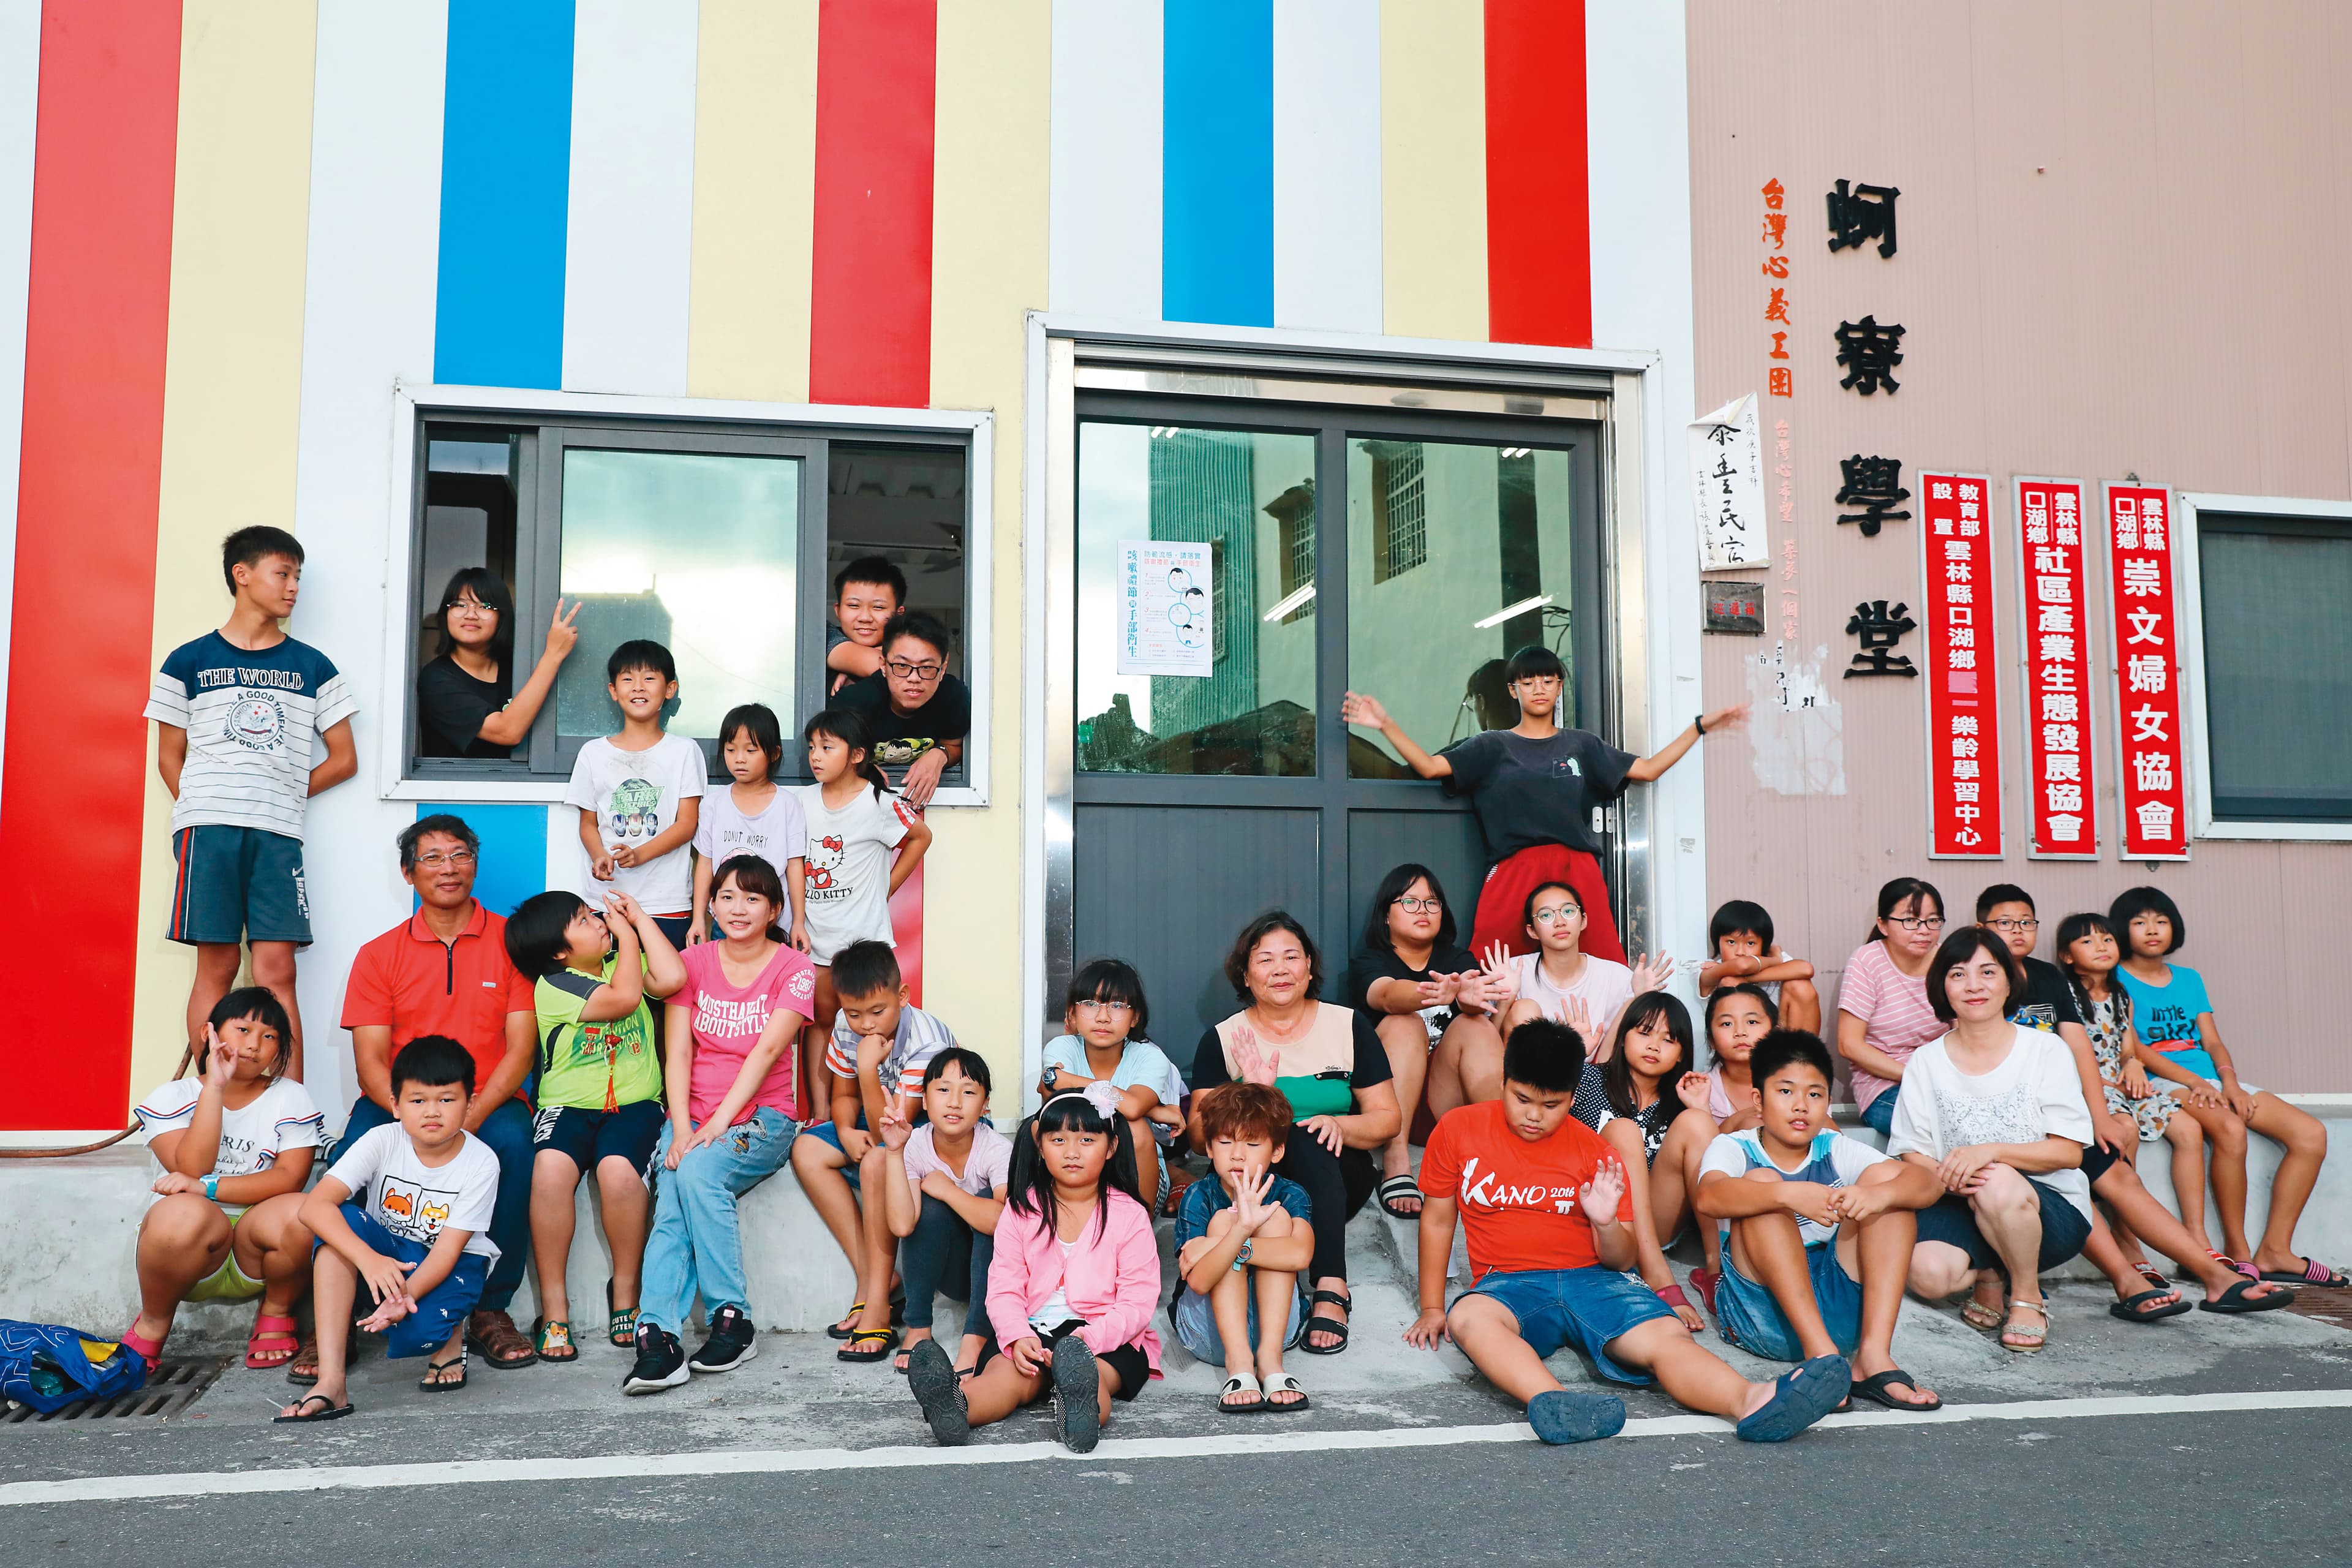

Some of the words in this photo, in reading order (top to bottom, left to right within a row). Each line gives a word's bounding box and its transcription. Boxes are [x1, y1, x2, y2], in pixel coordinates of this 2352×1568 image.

[1762, 178, 1792, 398] 台灣心義工團
[1826, 179, 1918, 679] 蚵寮學堂
[1932, 482, 1954, 536] 設置
[1959, 484, 1980, 537] 教育部
[2026, 491, 2048, 545] 口湖鄉
[2055, 492, 2078, 546] 雲林縣
[2115, 497, 2139, 549] 口湖鄉
[2141, 498, 2166, 551] 雲林縣
[197, 668, 235, 687] THE
[238, 667, 304, 690] WORLD
[246, 690, 275, 702] GOOD
[2035, 546, 2083, 841] 社區產業生態發展協會
[2123, 558, 2174, 840] 崇文婦女協會
[723, 830, 743, 843] DONUT
[747, 835, 769, 848] WORRY
[805, 889, 821, 900] LLO
[823, 886, 854, 899] KITTY
[2147, 1018, 2196, 1042] girl
[221, 1134, 255, 1152] ARIS
[1461, 1157, 1547, 1207] KANO
[1550, 1186, 1575, 1198] 2016
[612, 1315, 628, 1325] CUTE
